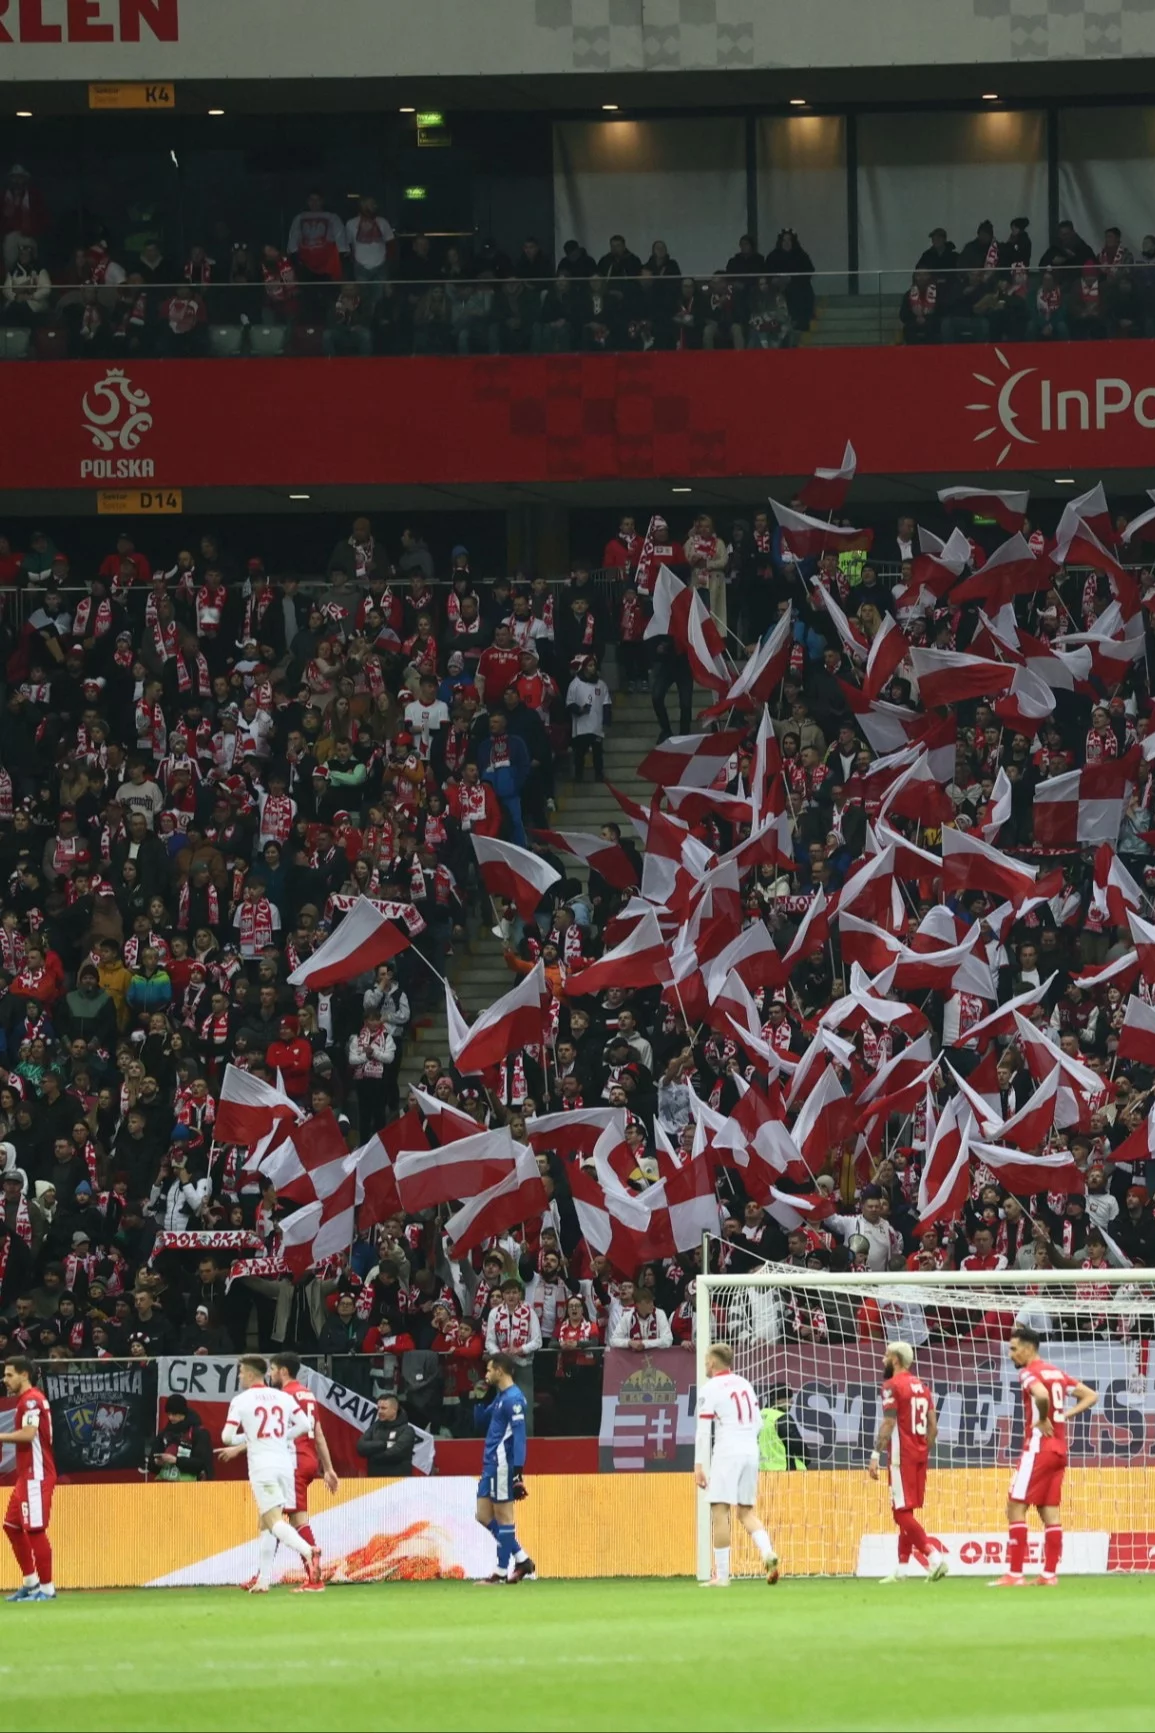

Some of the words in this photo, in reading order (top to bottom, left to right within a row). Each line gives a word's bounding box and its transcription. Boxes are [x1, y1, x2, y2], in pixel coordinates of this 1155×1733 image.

[145, 86, 170, 103] K4
[80, 458, 154, 478] POLSKA
[140, 492, 177, 508] D14
[46, 1370, 142, 1401] REPUBLIKA
[168, 1360, 240, 1393] GRY
[730, 1390, 752, 1424] 11
[911, 1397, 928, 1434] 13
[1051, 1382, 1065, 1422] 9
[254, 1406, 285, 1438] 23
[960, 1541, 1062, 1564] ORE
